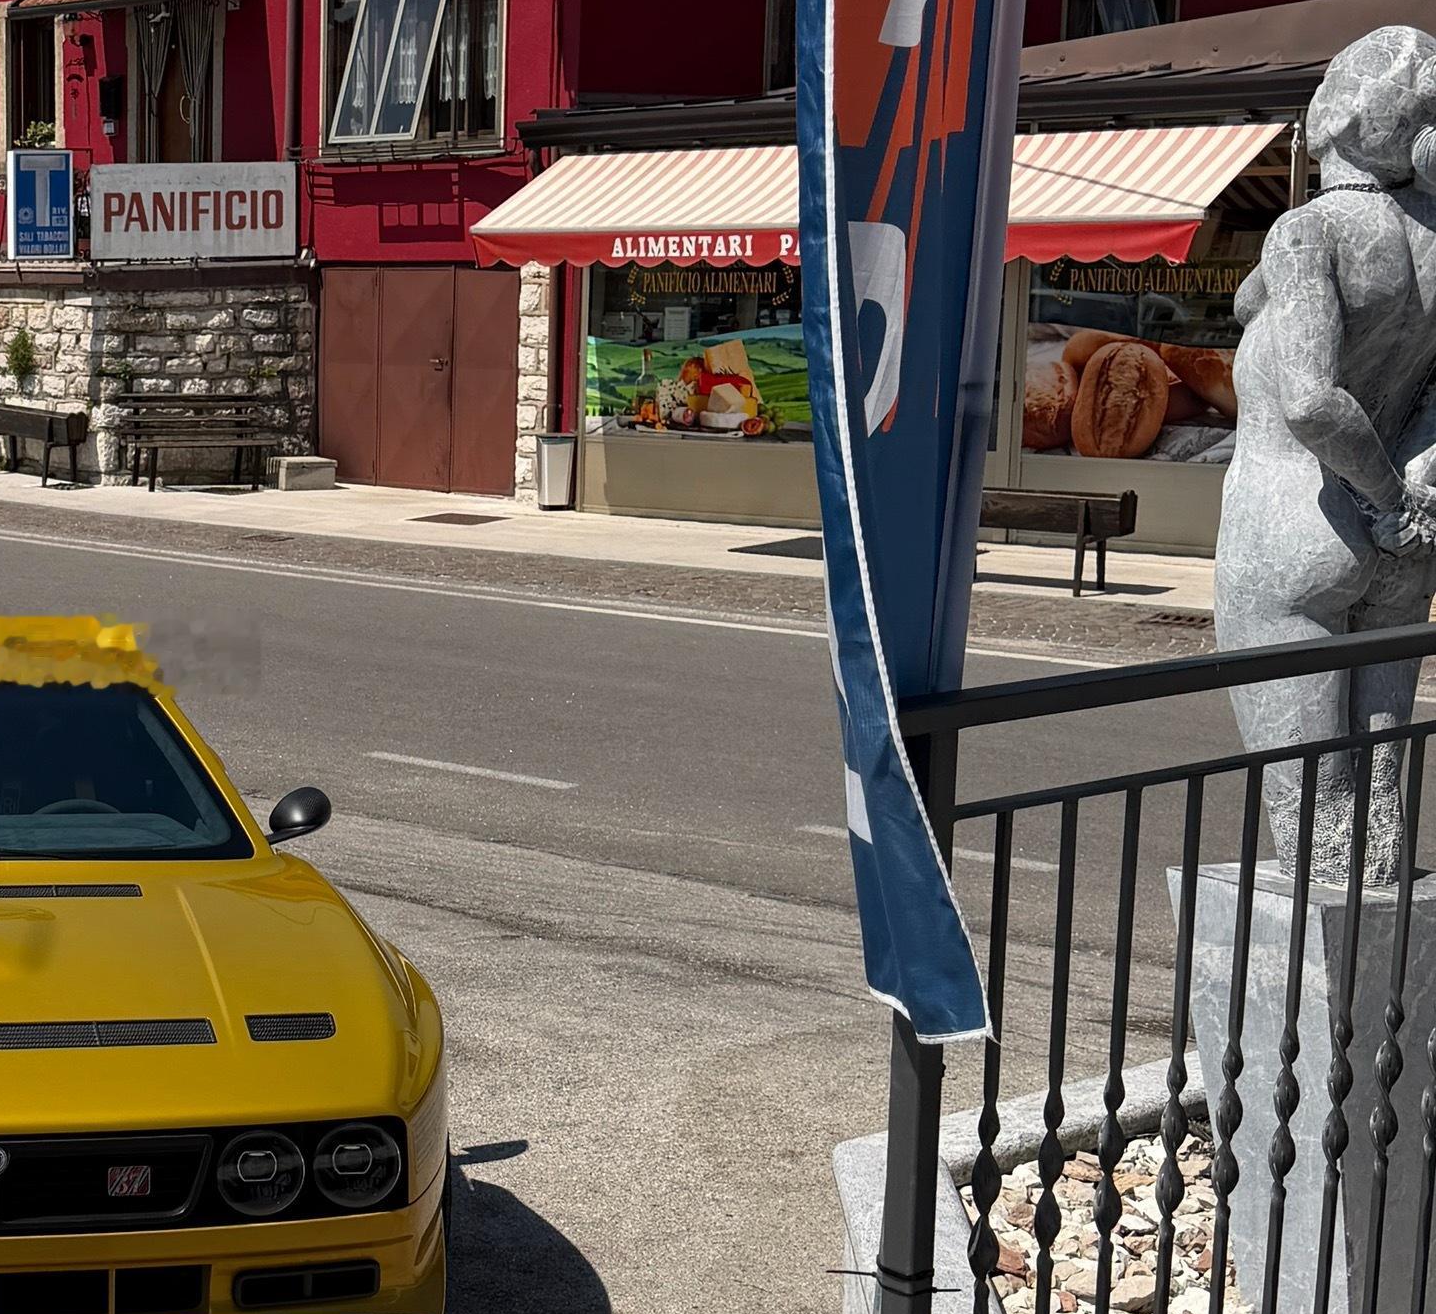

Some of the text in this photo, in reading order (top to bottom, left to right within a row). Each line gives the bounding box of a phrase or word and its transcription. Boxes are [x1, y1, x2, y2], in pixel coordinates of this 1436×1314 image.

[20, 155, 66, 227] T
[103, 189, 284, 232] PANIFICIO
[611, 235, 753, 258] ALIMENTARI
[643, 271, 777, 293] PANIFICIO ALIMENTARI
[1070, 268, 1241, 293] PANIFICIO ALIMENTARI
